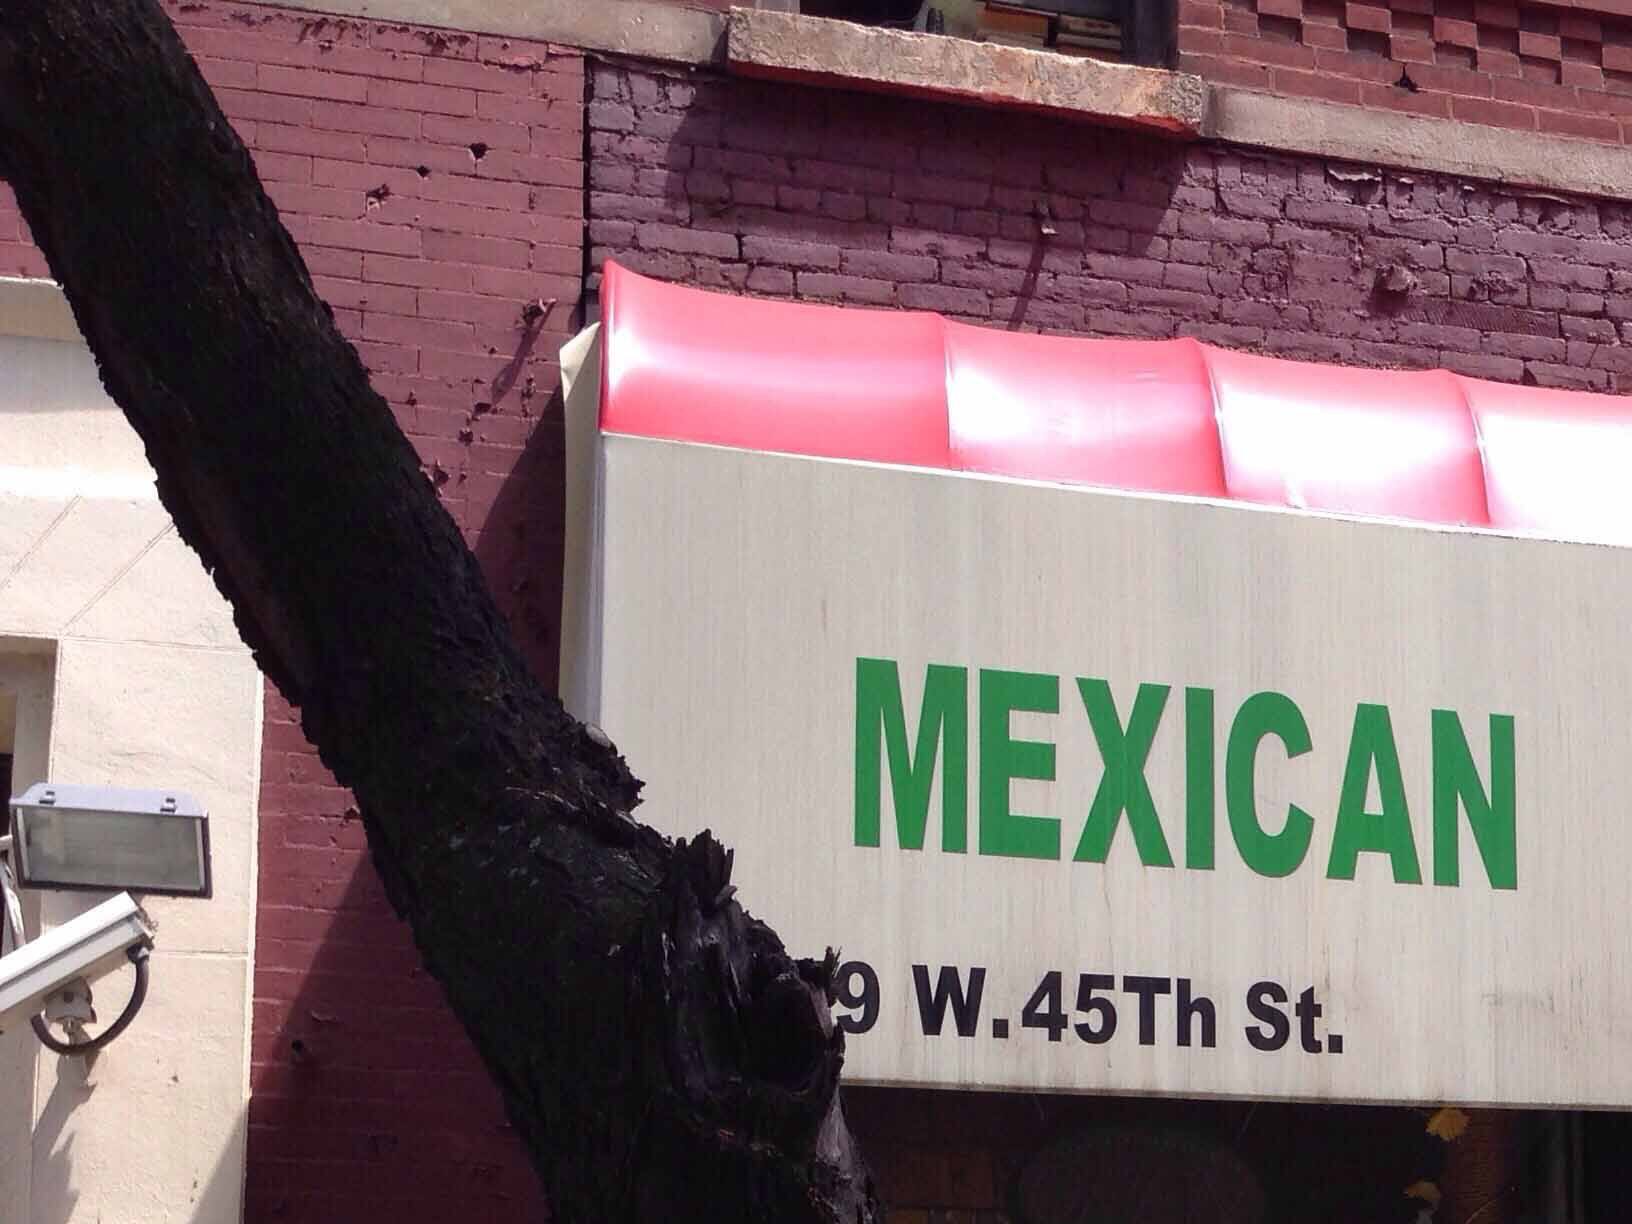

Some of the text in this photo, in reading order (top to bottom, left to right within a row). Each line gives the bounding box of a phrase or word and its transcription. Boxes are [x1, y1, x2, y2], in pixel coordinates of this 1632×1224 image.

[854, 656, 1519, 891] MEXICAN
[837, 961, 880, 1035] 9
[1245, 980, 1344, 1055] St.
